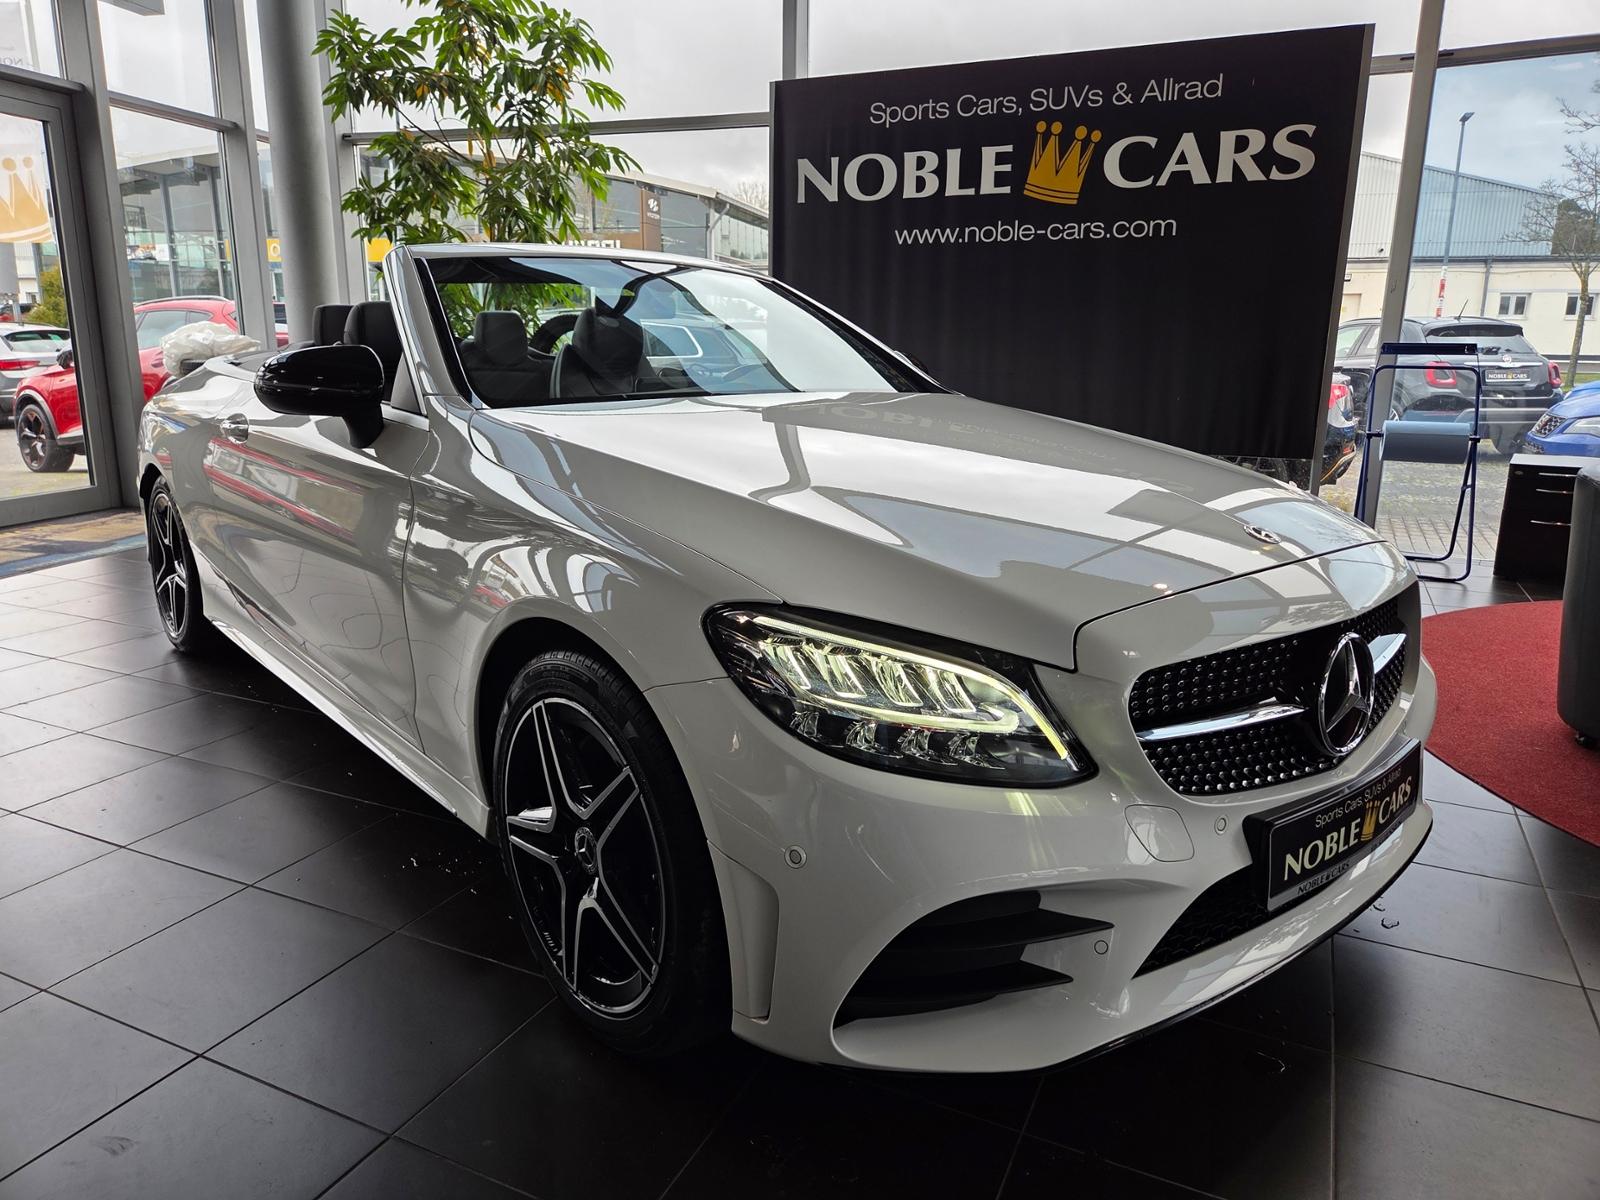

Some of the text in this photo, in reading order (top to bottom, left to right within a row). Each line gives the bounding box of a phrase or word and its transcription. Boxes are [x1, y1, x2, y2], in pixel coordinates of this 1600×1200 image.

[869, 73, 1224, 128] Sports Cars, SUVs & Allrad
[796, 123, 1317, 204] NOBLE CARS
[894, 219, 1177, 245] www.noble-cars.com
[1283, 776, 1412, 881] NOBLE CARS
[1315, 806, 1343, 828] Sports
